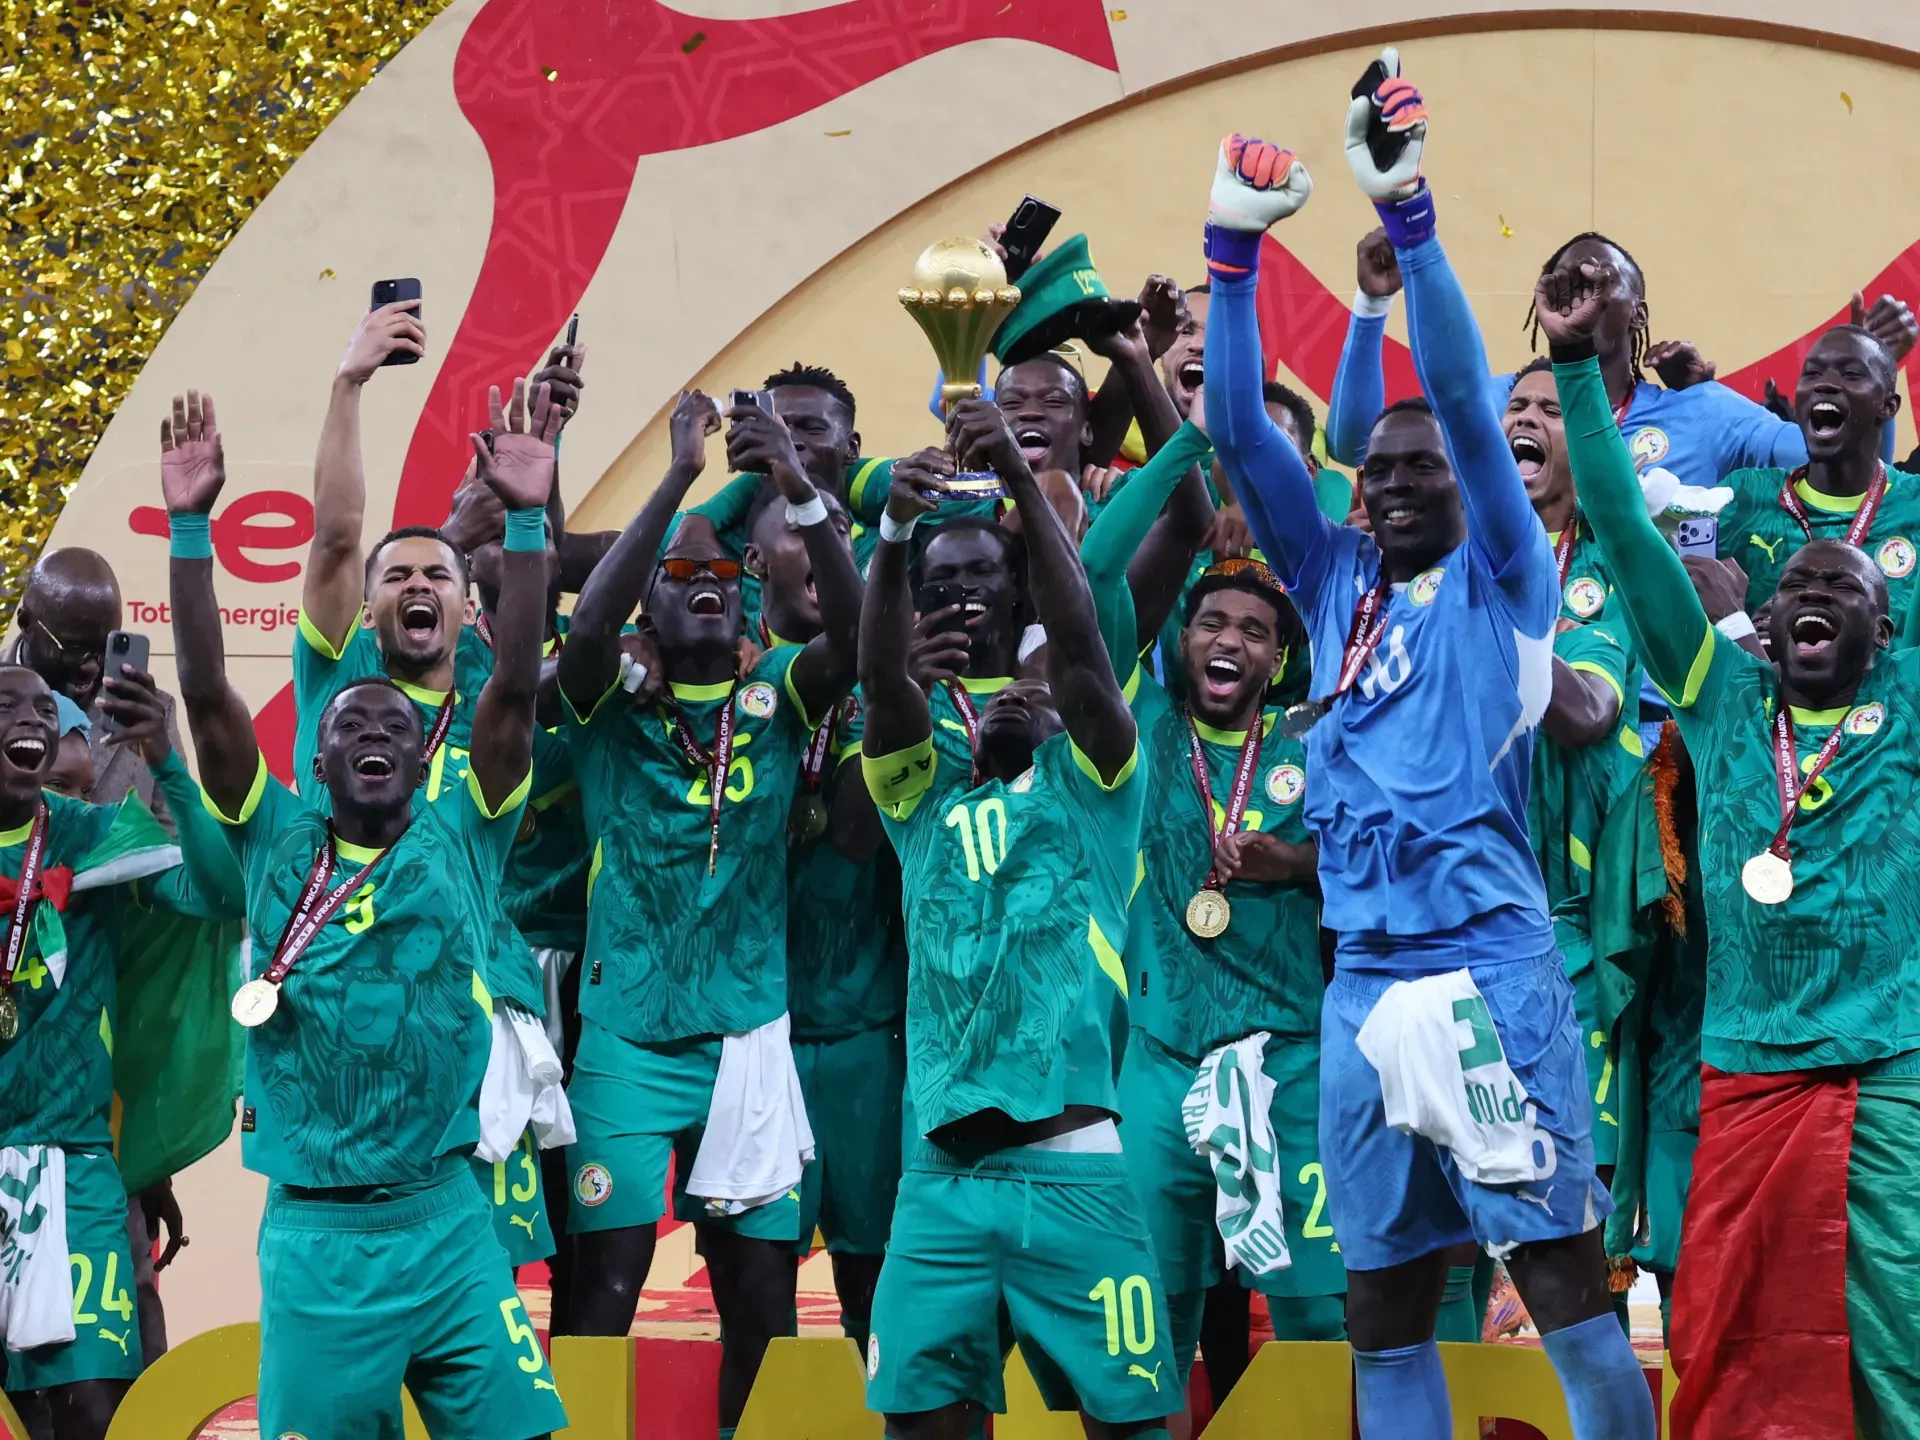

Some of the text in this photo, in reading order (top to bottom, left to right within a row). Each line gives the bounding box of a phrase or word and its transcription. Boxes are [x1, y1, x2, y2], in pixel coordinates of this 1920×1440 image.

[1852, 526, 1861, 539] OF
[1857, 501, 1874, 529] NATIONS
[127, 601, 301, 632] Totnergie
[1355, 614, 1371, 646] AFRICA
[1364, 594, 1375, 614] CUP
[1367, 618, 1387, 646] AFRICA
[1362, 624, 1412, 700] 16
[721, 709, 729, 721] OF
[721, 720, 729, 736] CUP
[719, 736, 728, 764] AFRICA
[1243, 741, 1256, 770] NATIONS
[1781, 737, 1790, 750] OF
[1820, 744, 1832, 761] CUP
[889, 756, 932, 786] AF
[1782, 750, 1792, 767] CUP
[1236, 781, 1246, 797] CUP
[1239, 769, 1249, 782] OF
[1785, 768, 1795, 798] AFRICA
[1230, 795, 1242, 822] AFRICA
[28, 835, 42, 868] NATIONS
[946, 797, 1007, 881] 10
[21, 878, 32, 896] CUP
[25, 866, 34, 880] OF
[301, 882, 321, 913] AFRICA
[315, 866, 328, 884] CUP
[15, 894, 28, 924] AFRICA
[293, 927, 312, 949] CAF
[313, 896, 336, 924] AFRICA
[333, 883, 348, 898] CUP
[9, 931, 20, 955] CAF
[69, 1251, 134, 1325] 24
[1088, 1274, 1156, 1357] 10
[499, 1296, 544, 1374] 5
